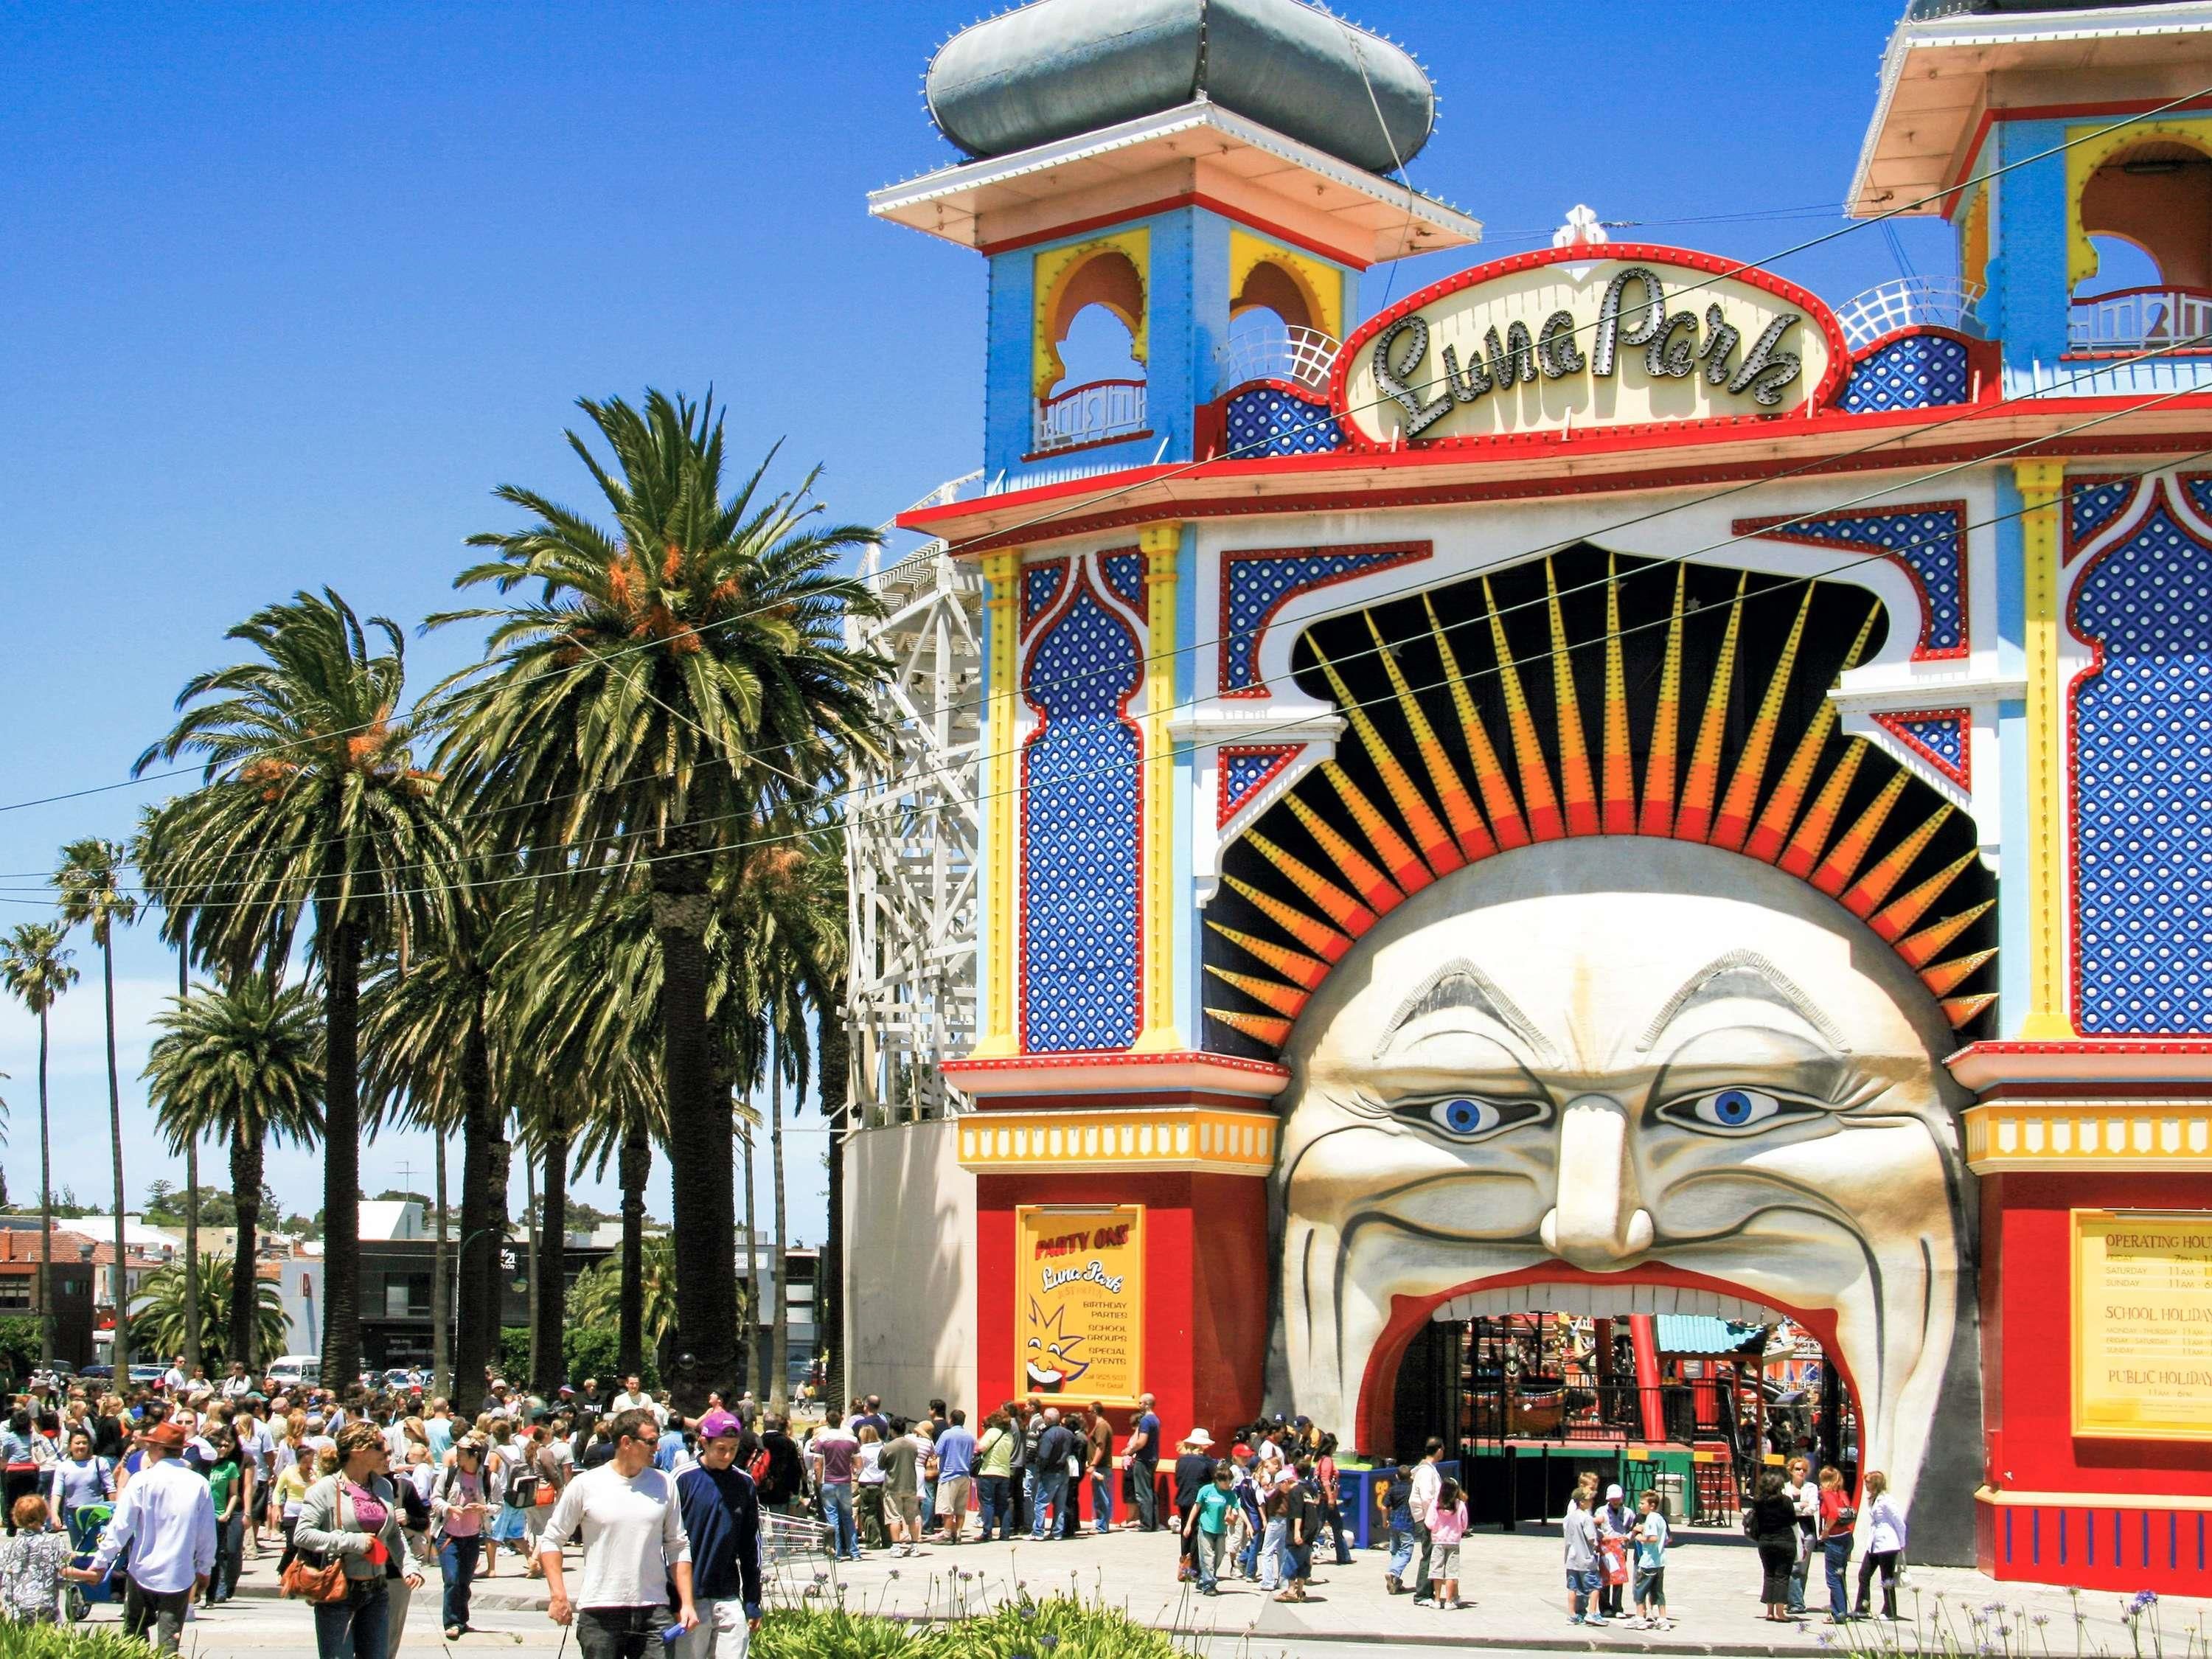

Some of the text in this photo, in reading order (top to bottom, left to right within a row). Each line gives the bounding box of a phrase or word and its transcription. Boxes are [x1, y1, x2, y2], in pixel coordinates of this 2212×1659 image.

[1372, 266, 1801, 437] Luna Park
[2106, 1234, 2180, 1248] OPERATING
[1034, 1231, 1090, 1261] PARTY
[2107, 1253, 2134, 1262] FRIDAY
[2106, 1267, 2147, 1275] SATURDAY
[1042, 1259, 1124, 1293] Luna Park
[1091, 1311, 1127, 1319] PARTIES
[2105, 1306, 2158, 1321] SCHOOL
[1088, 1324, 1127, 1332] SCHOOL
[1087, 1334, 1127, 1343] GROUPS
[1088, 1347, 1126, 1355] SPECIAL
[1090, 1357, 1127, 1365] EVENTS
[2109, 1369, 2156, 1384] PUBLIC
